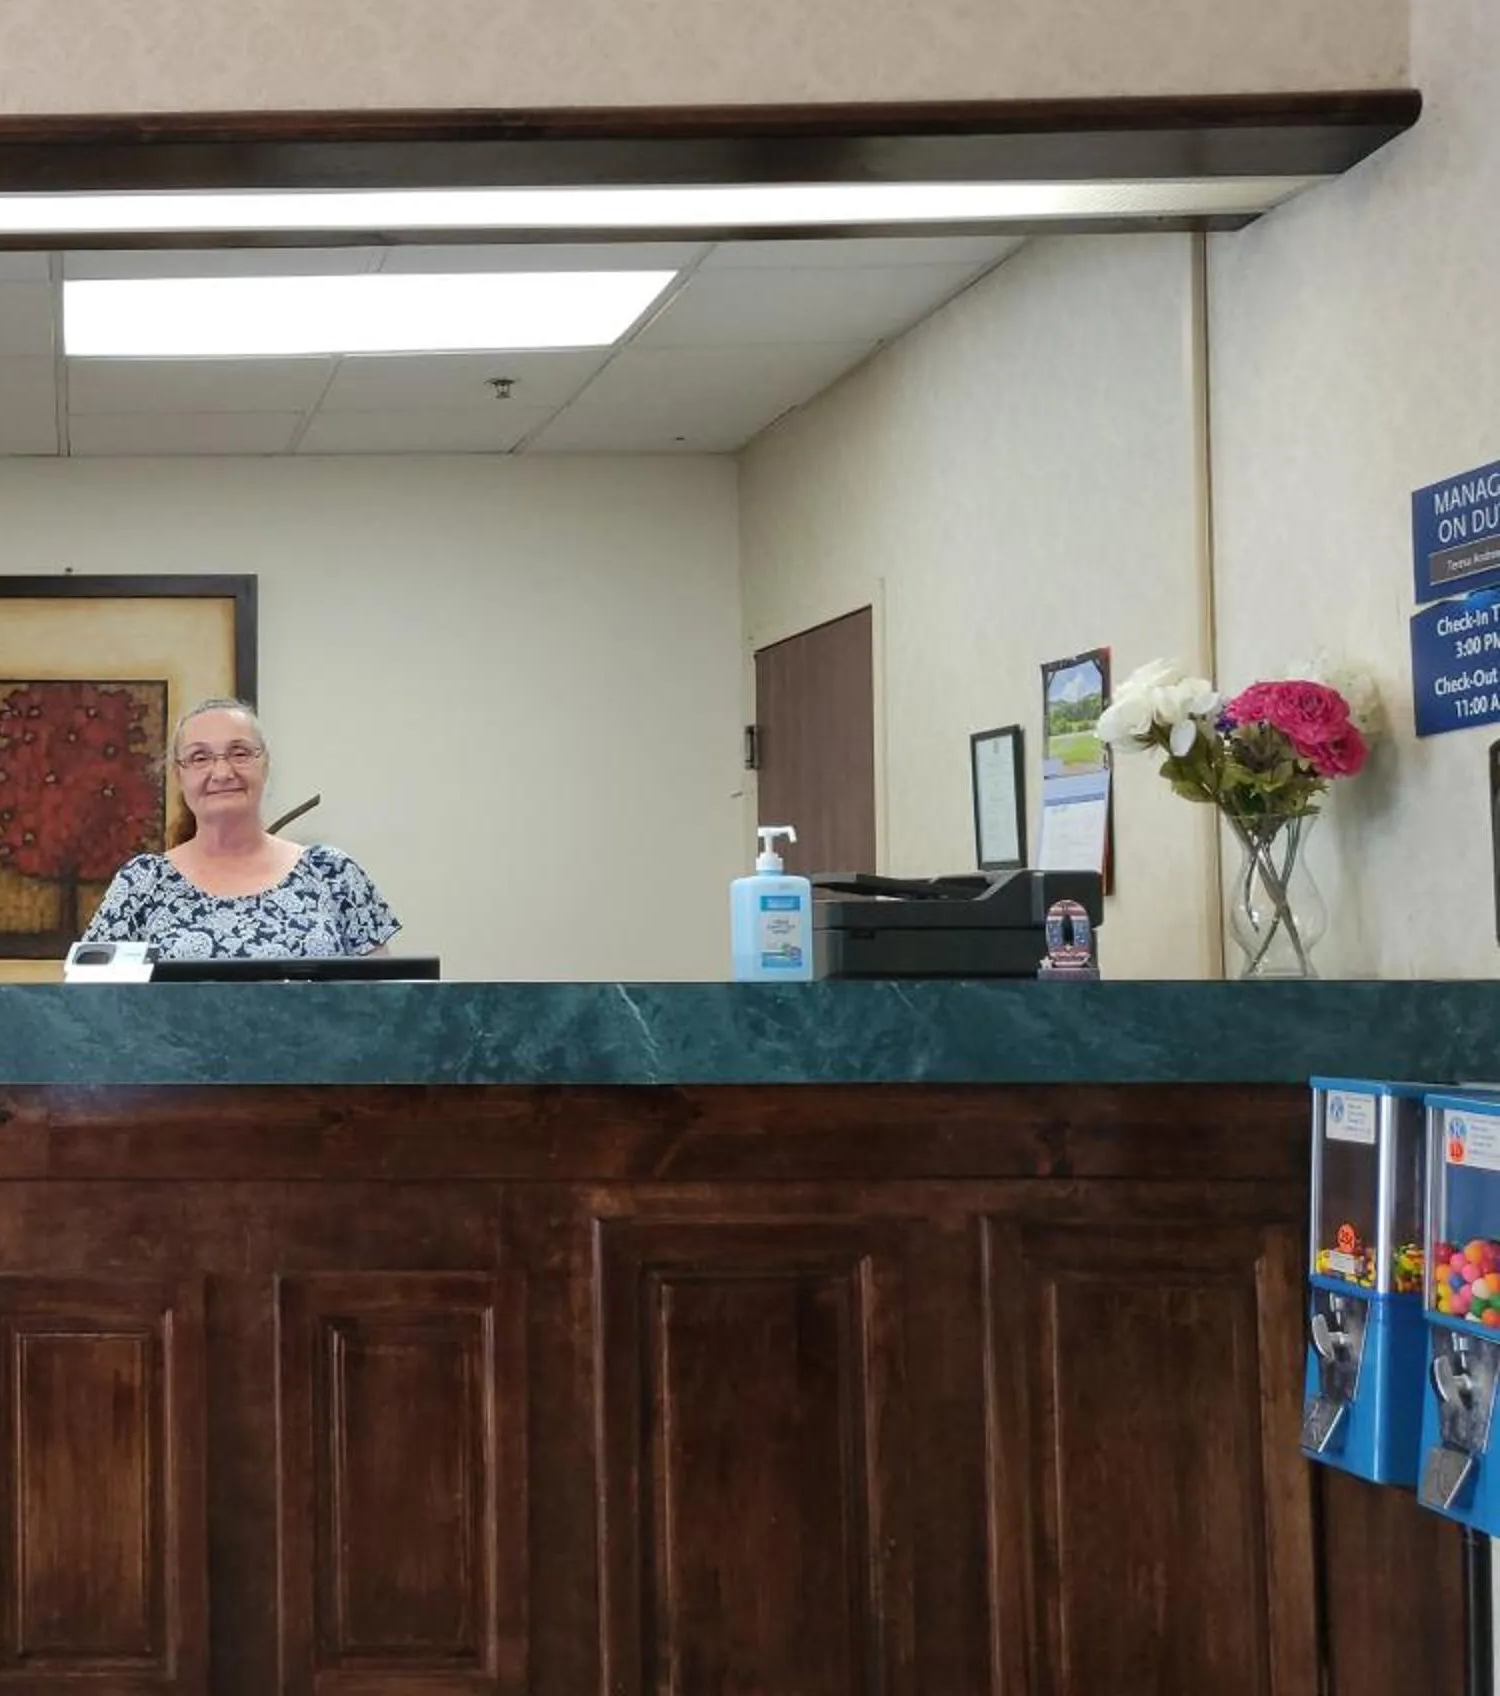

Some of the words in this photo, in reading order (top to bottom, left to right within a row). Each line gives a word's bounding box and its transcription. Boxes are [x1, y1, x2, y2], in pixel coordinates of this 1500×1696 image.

[1439, 514, 1467, 543] ON
[1437, 610, 1489, 637] Check-In
[1454, 636, 1481, 659] 3:00
[1435, 668, 1498, 696] Check-Out
[1454, 695, 1488, 720] 11:00
